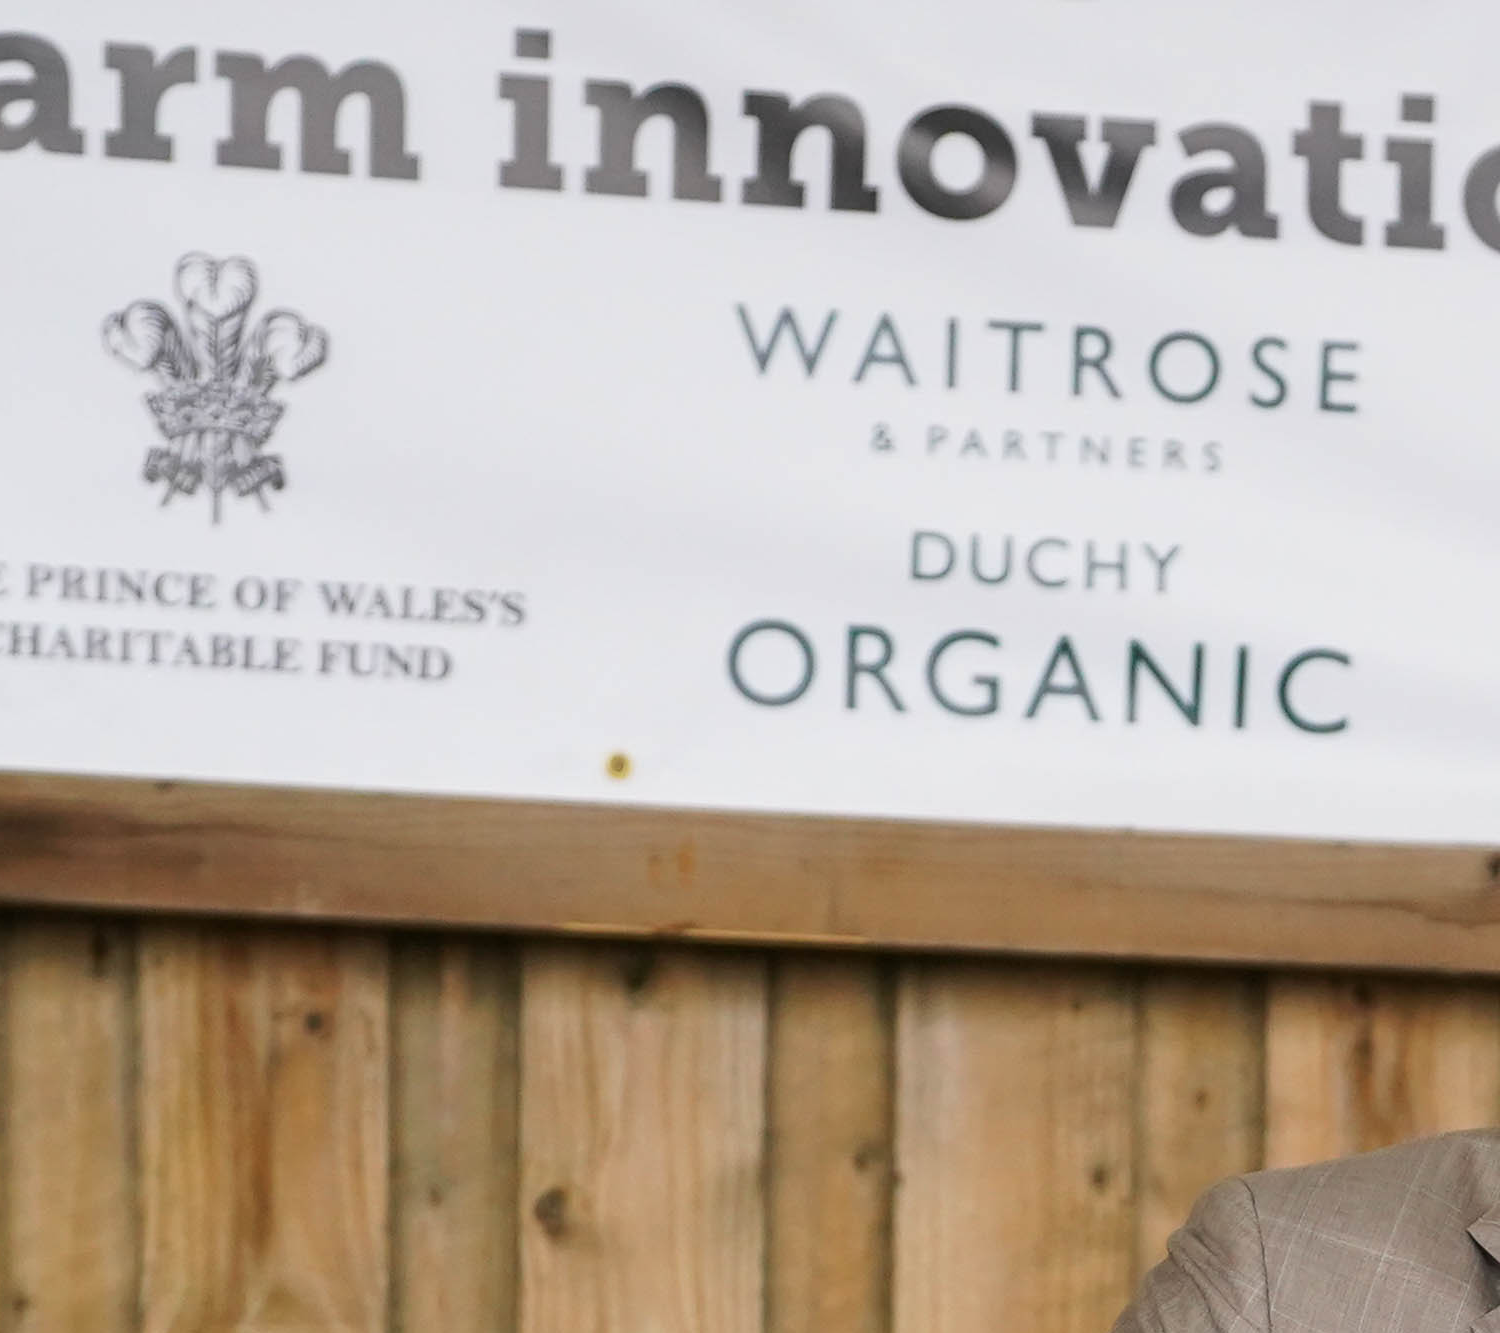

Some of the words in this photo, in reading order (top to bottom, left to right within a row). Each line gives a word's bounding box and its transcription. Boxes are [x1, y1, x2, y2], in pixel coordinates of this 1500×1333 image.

[735, 301, 1360, 414] WAITROSE
[869, 423, 898, 453] &
[926, 424, 1224, 475] PARTNERS
[26, 561, 216, 611] PRINCE
[233, 573, 302, 615] OF
[315, 580, 527, 628] WALES'S
[909, 529, 1184, 594] DUCHY
[317, 639, 452, 683] FUND
[726, 616, 1353, 736] ORGANIC
